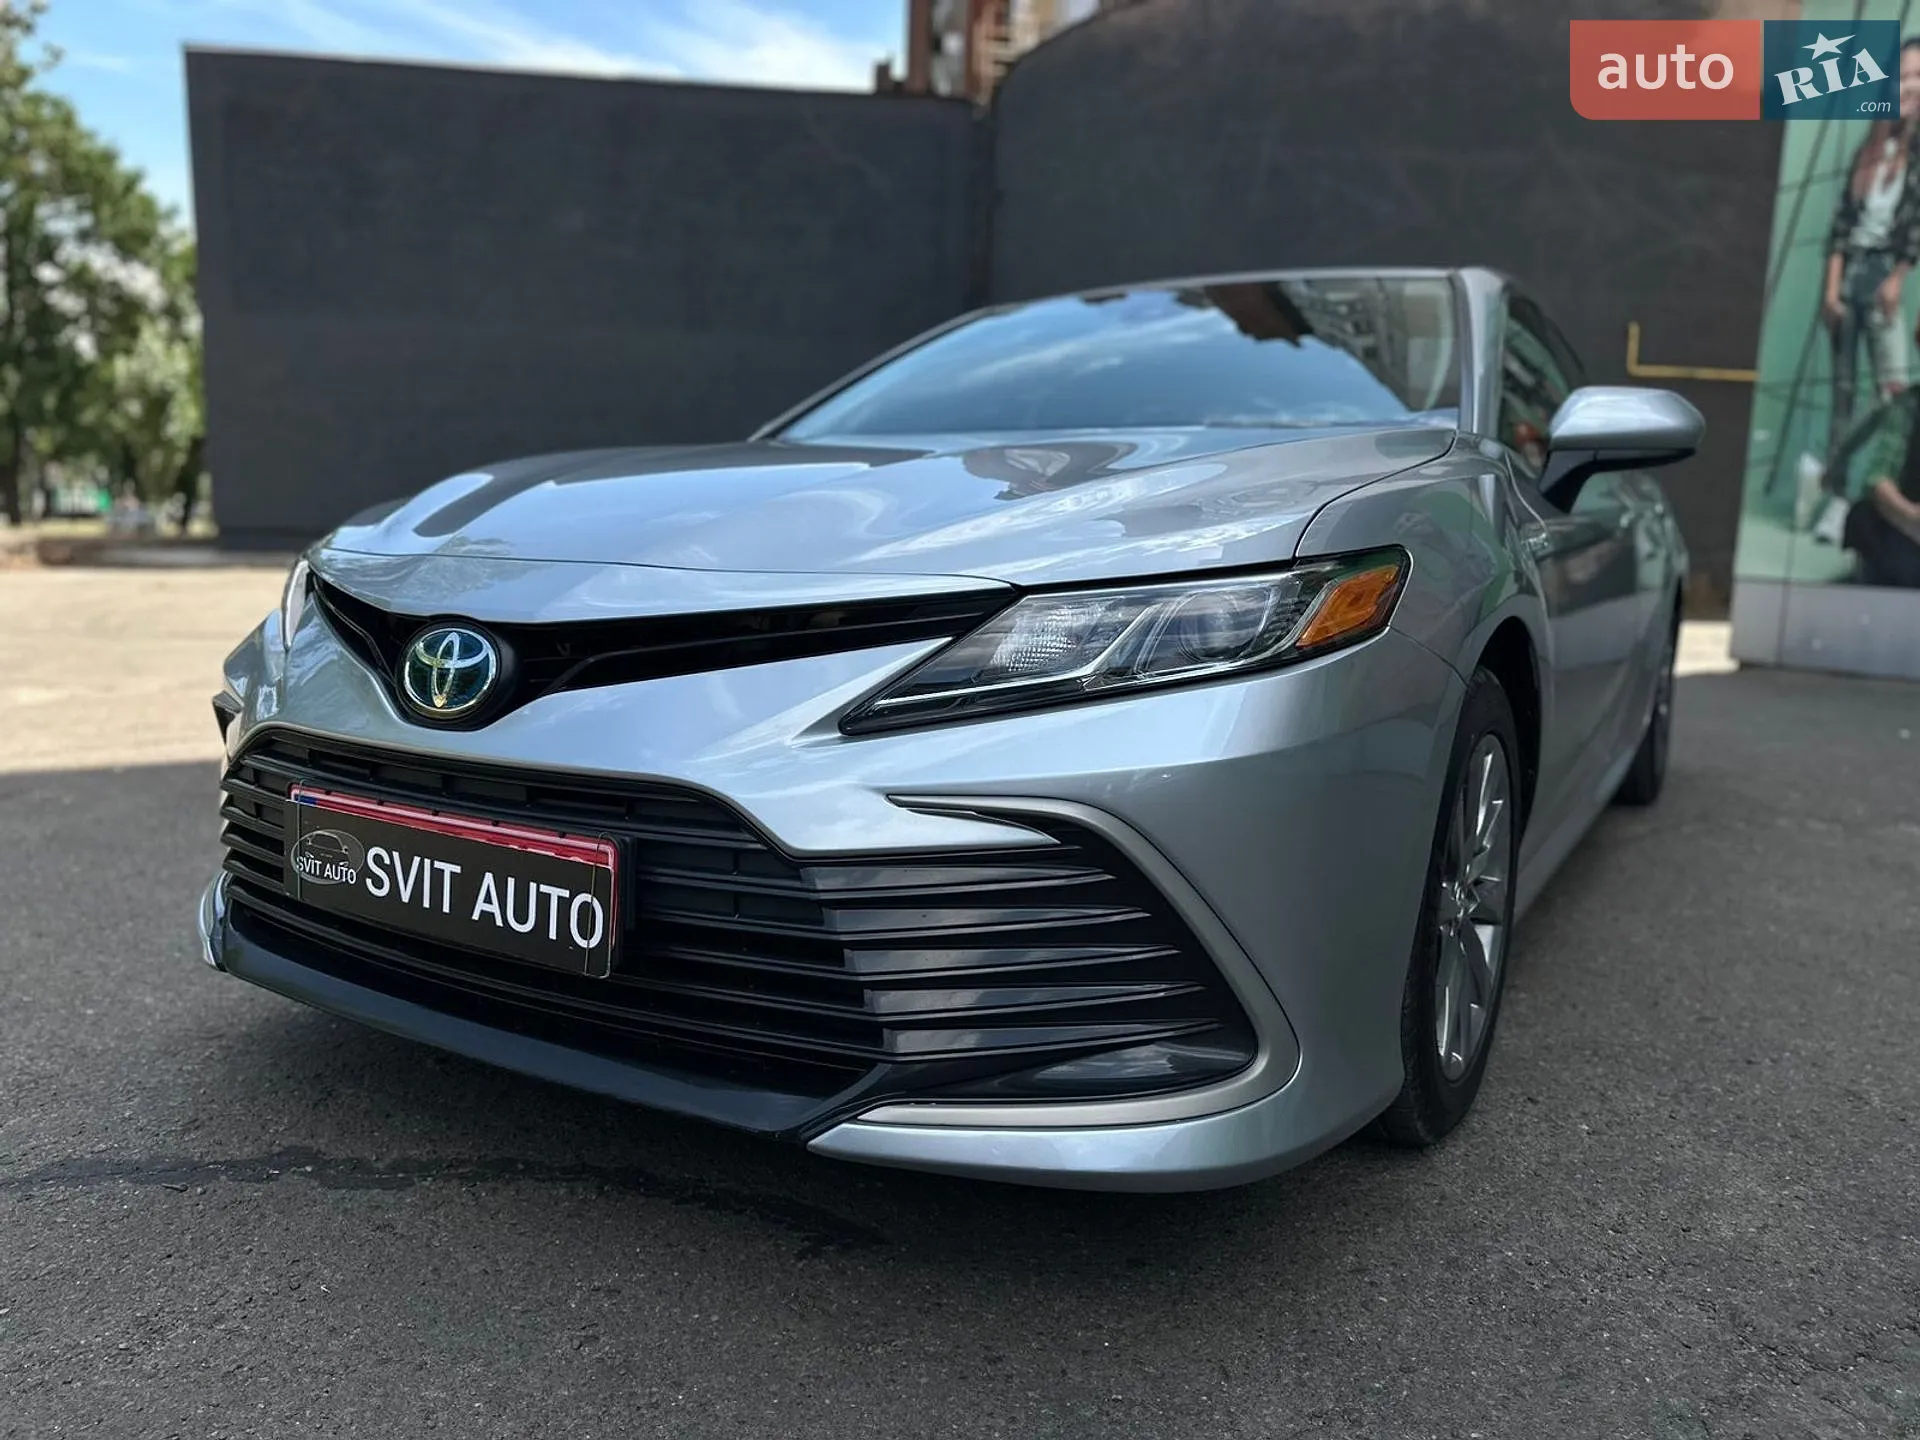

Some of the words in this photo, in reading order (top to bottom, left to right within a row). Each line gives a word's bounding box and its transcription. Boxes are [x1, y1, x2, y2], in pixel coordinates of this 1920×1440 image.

[296, 856, 322, 876] SVIT
[323, 862, 357, 885] AUTO
[365, 846, 462, 914] SVIT
[471, 871, 604, 950] AUTO
